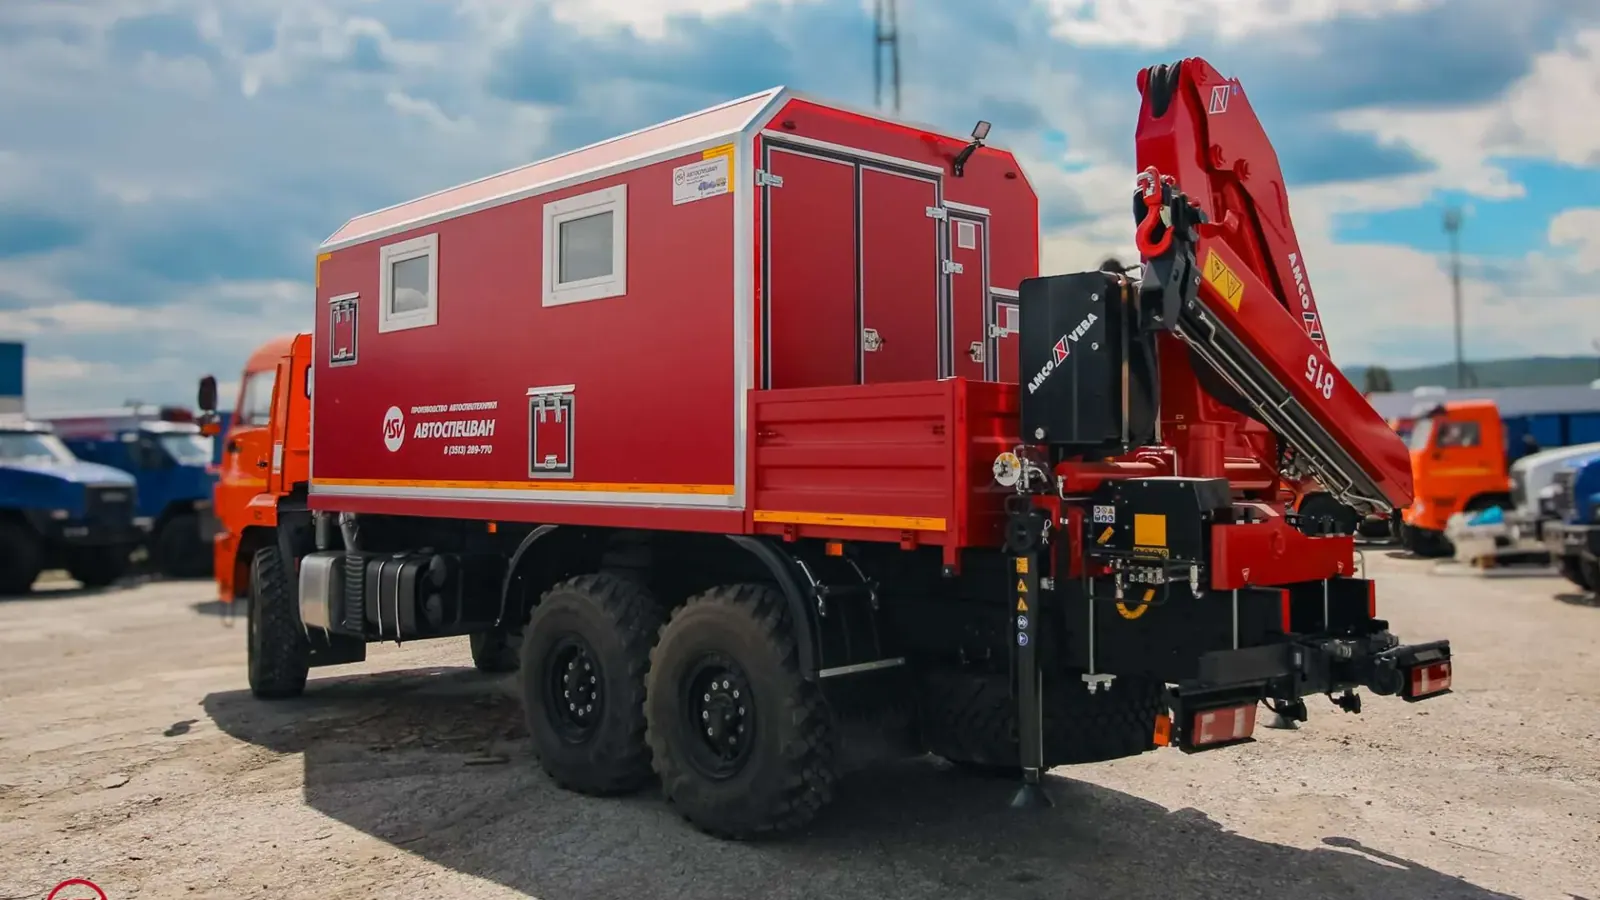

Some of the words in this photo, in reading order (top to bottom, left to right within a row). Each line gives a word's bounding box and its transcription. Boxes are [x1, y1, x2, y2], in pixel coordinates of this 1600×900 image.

[1287, 252, 1310, 310] AMCO
[1027, 360, 1054, 394] AMCO
[1067, 312, 1098, 342] VEBA
[1305, 354, 1334, 400] 815
[413, 419, 496, 439] АВТОСПЕЦВАН
[467, 445, 493, 455] 289-770
